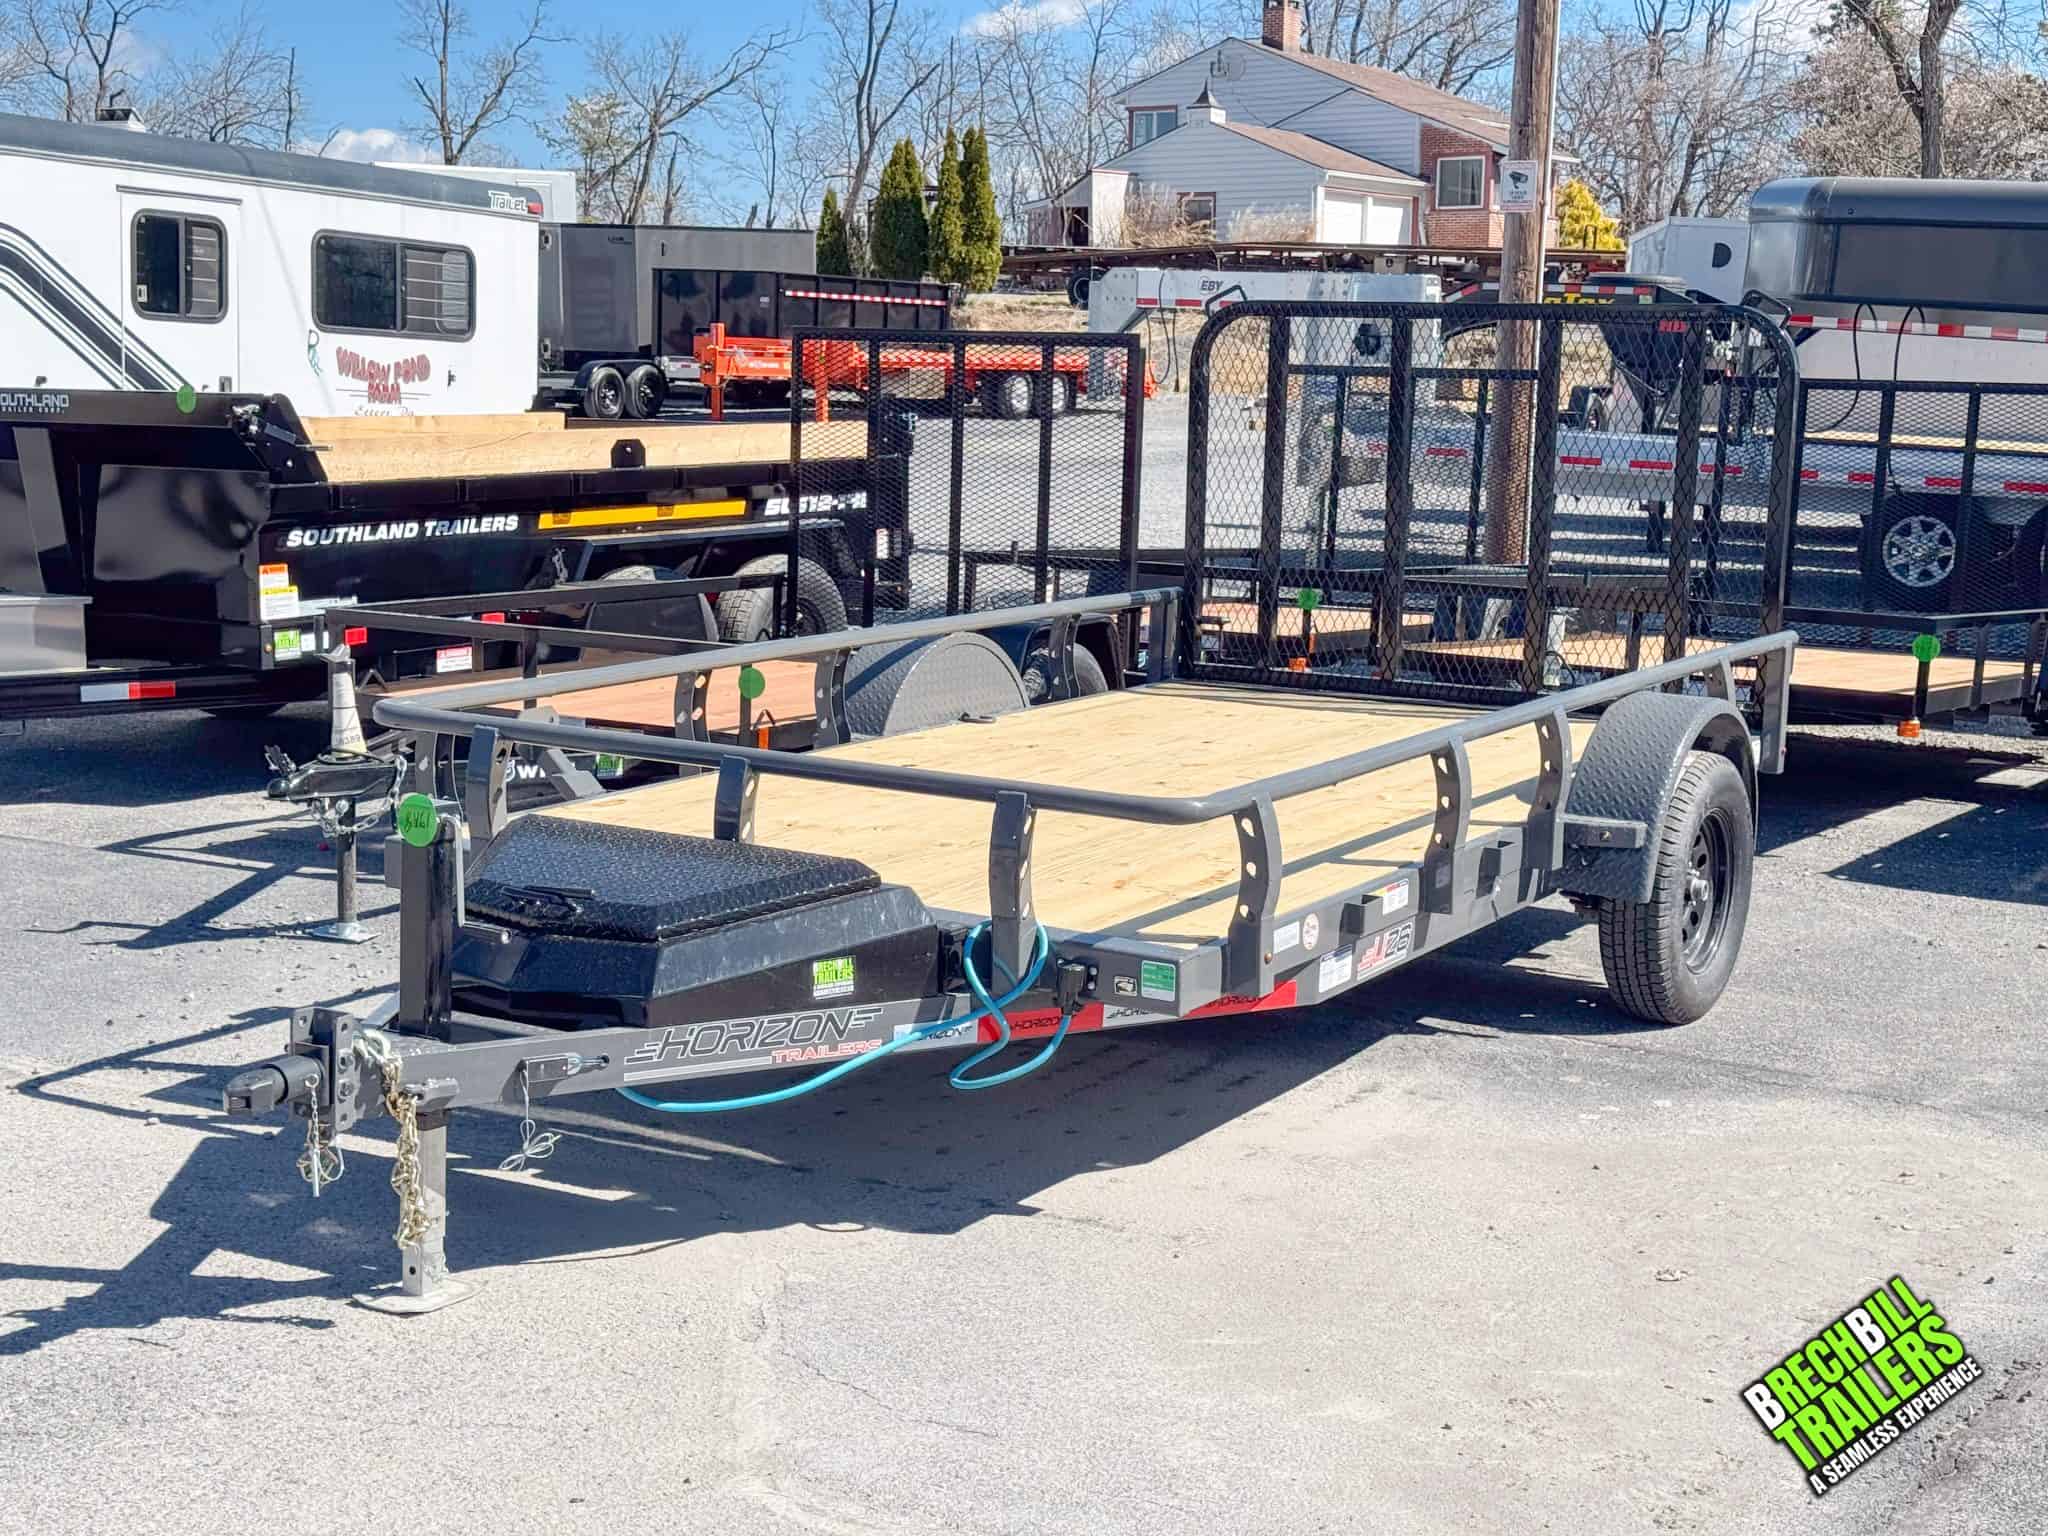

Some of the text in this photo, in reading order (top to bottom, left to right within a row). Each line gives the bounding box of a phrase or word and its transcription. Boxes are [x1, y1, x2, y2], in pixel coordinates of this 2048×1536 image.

[1201, 280, 1224, 291] EBY
[0, 393, 70, 407] OUTHLAND
[286, 515, 519, 547] SOUTHLAND TRAILERS
[1014, 1015, 1063, 1031] HORIZO
[654, 1010, 856, 1061] HORIZON
[771, 1039, 882, 1064] TRAILERS
